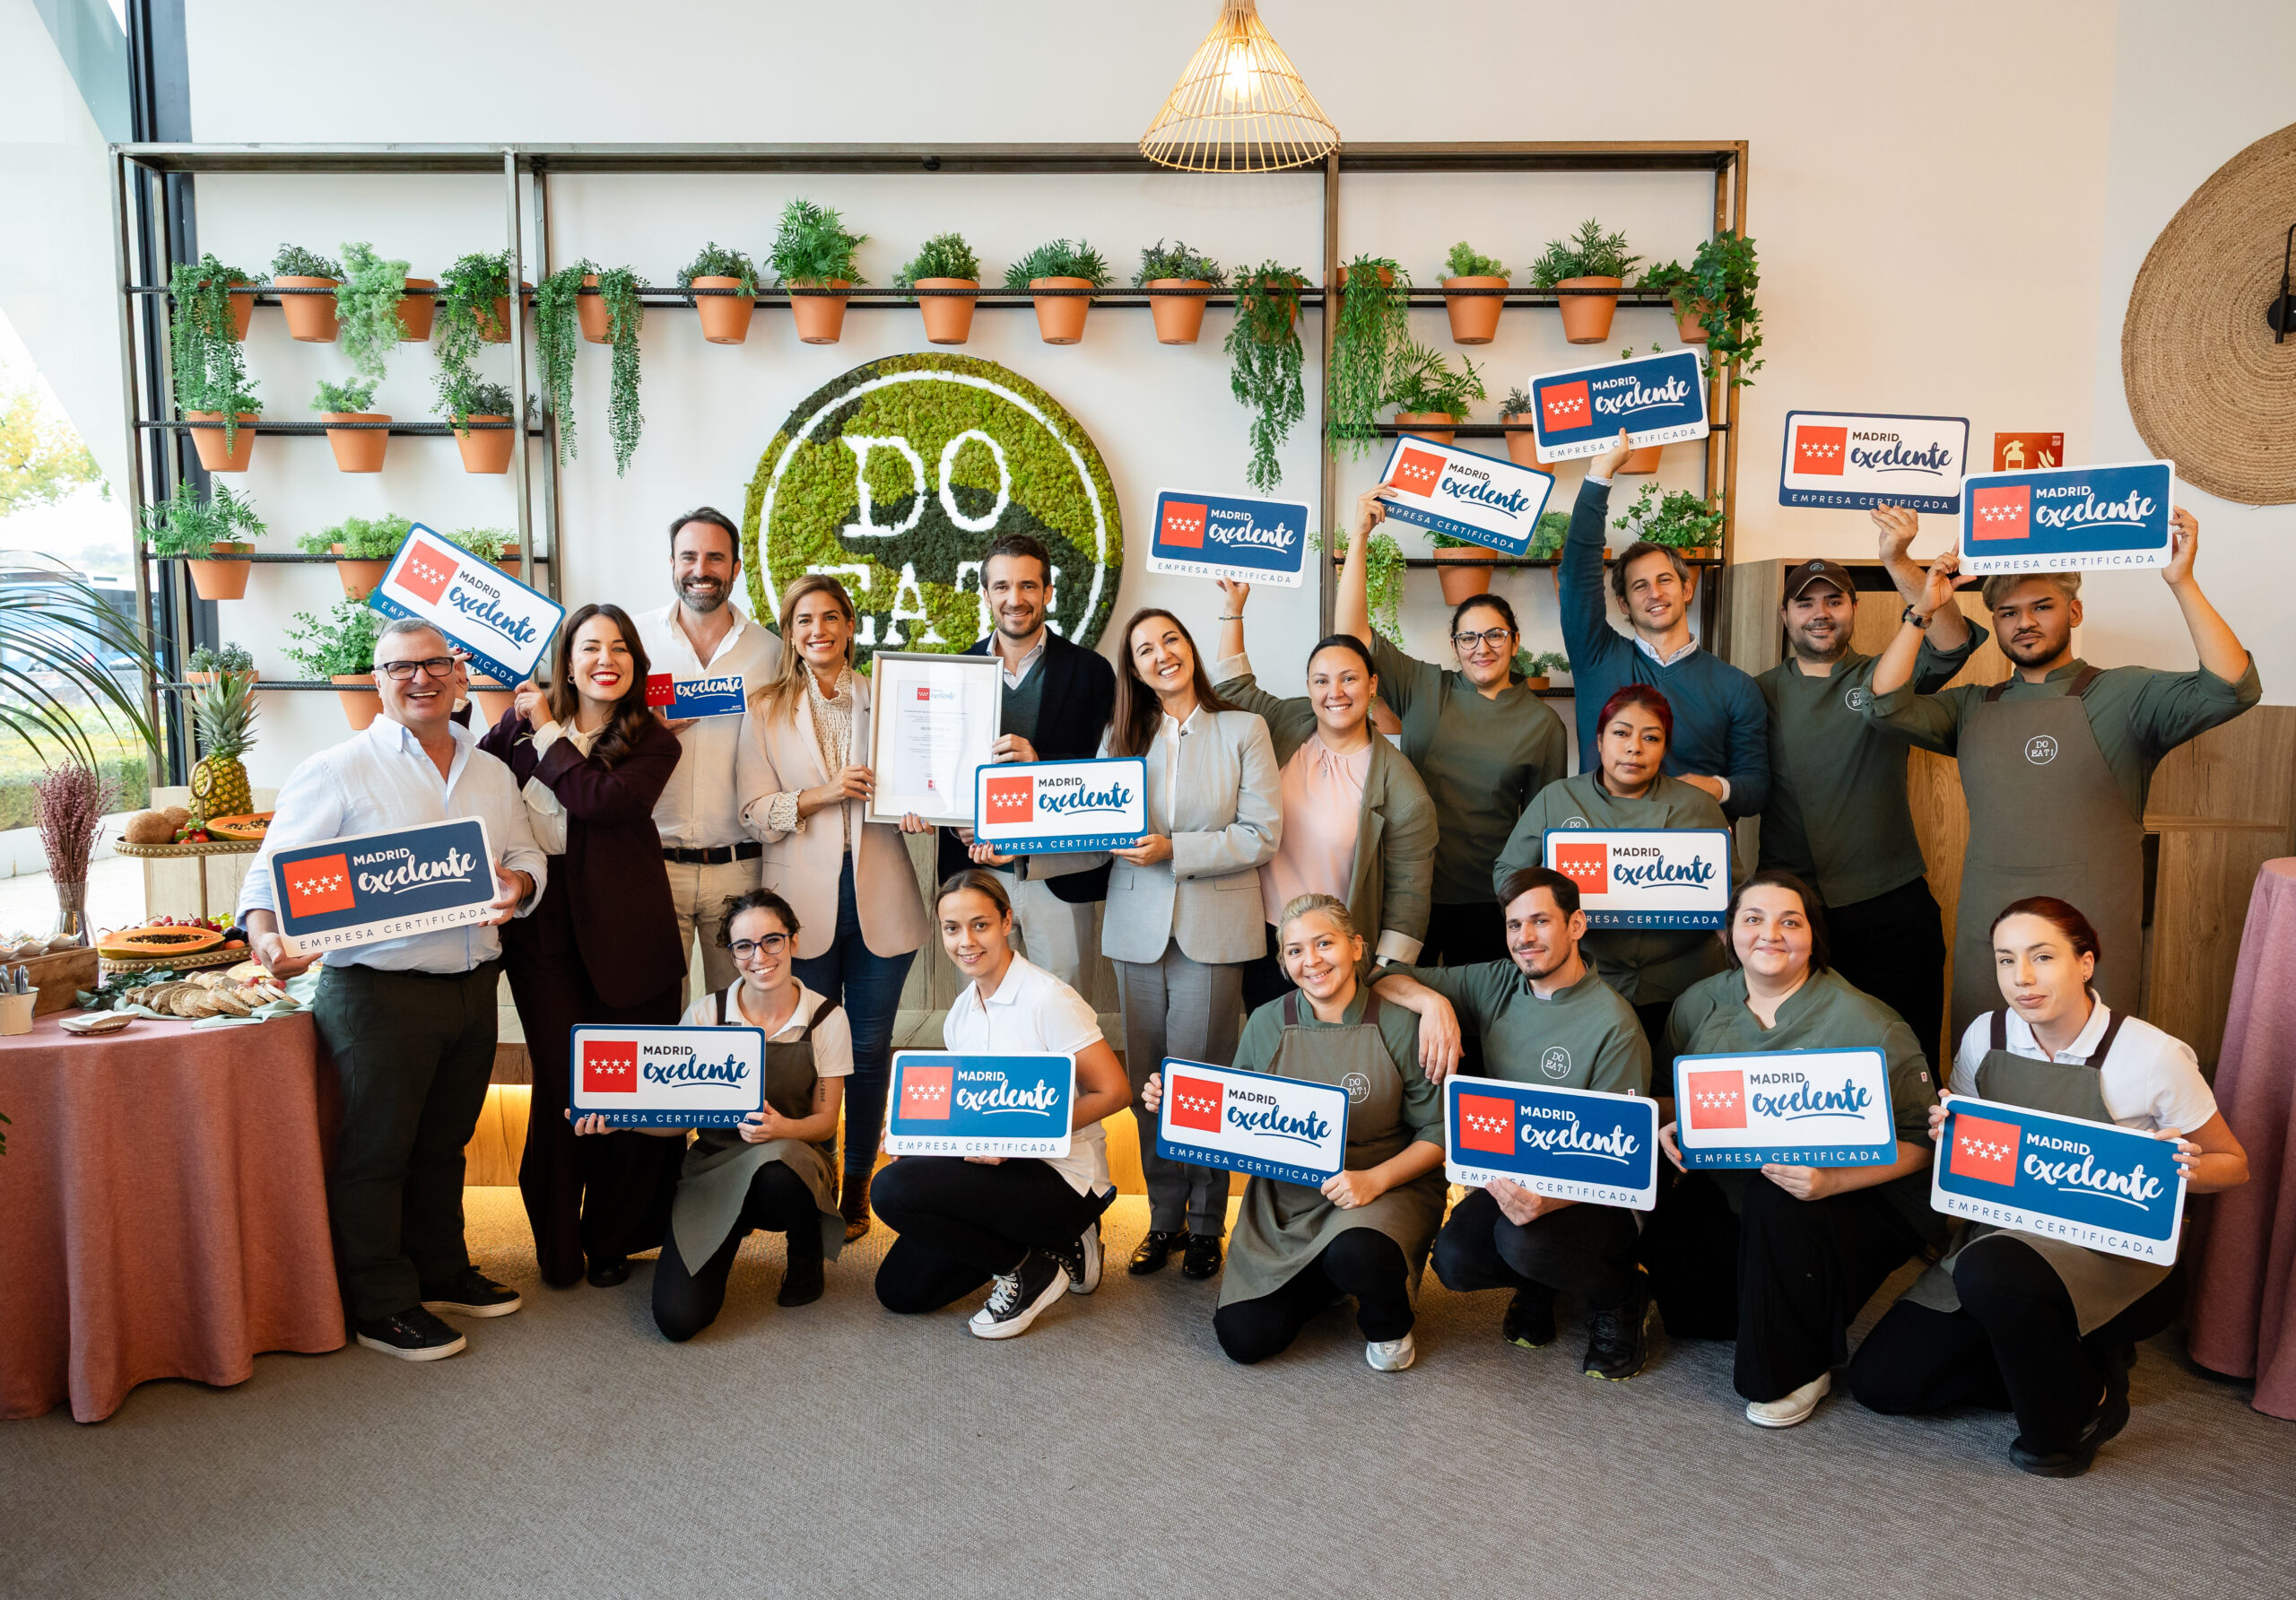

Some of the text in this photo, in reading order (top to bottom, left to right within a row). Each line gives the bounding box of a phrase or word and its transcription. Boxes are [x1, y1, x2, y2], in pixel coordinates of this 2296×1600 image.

[1592, 376, 1637, 391] MADRID
[1595, 375, 1691, 414] excelente
[1550, 428, 1696, 458] EMPRESA CRTIFICADA
[1852, 431, 1900, 442] MADRID
[1850, 440, 1952, 469] excelente
[1448, 463, 1490, 481] MADRID
[841, 430, 1012, 537] DO
[2036, 485, 2092, 499] MADRID
[1441, 477, 1531, 512] excelente
[1792, 494, 1948, 509] EMPRESA CERTIFICADA
[1211, 509, 1252, 521] MADRID
[2036, 490, 2156, 527] excelente
[1208, 519, 1296, 548] excelente
[1437, 520, 1515, 550] CERTIFICADA
[1158, 562, 1291, 583] EMPRESA CERTIFICADA
[1973, 555, 2155, 570] EMPRESA CERTIFICADA
[459, 570, 500, 599] MADRID
[449, 586, 536, 644] excelente
[676, 674, 744, 697] excelente
[2031, 749, 2054, 757] EAT!
[2036, 740, 2048, 748] DO
[1039, 777, 1083, 787] MADRID
[1039, 782, 1134, 813] excelente
[995, 837, 1135, 850] MPRESA CERTIFICADA
[1613, 848, 1661, 857] MADRID
[352, 848, 410, 866] MADRID
[358, 848, 477, 894] excelente
[1613, 855, 1717, 885] excelente
[300, 908, 488, 950] EMPRESA CERTIFICADA
[1586, 915, 1718, 924] RESA CERTIFICADA
[643, 1046, 693, 1056] MADRID
[1552, 1051, 1564, 1062] DO
[643, 1054, 750, 1084] excelente
[957, 1071, 1005, 1082] MADRID
[1545, 1059, 1567, 1074] EAT!
[1348, 1078, 1361, 1086] DO
[1750, 1073, 1805, 1084] MADRID
[956, 1078, 1059, 1111] excelente
[1229, 1089, 1277, 1106] MADRID
[1752, 1078, 1873, 1117] excelente
[584, 1114, 750, 1123] EPRESA CERTIFICADA
[1227, 1104, 1332, 1140] excelente
[1520, 1105, 1576, 1122] MADRID
[898, 1141, 1057, 1152] EMPRESA CERTIFICADA
[1521, 1119, 1639, 1157] excelente
[2026, 1133, 2091, 1155] MADRID
[1170, 1146, 1327, 1184] EMPRESA CERTIFICADA
[1695, 1151, 1880, 1163] EMPRESA CERTIFICADA
[1461, 1170, 1638, 1204] EMPRSA CERTIFICADA
[2023, 1153, 2164, 1201] excelente
[1948, 1198, 2154, 1257] EMPRESA CERTIFICADA
